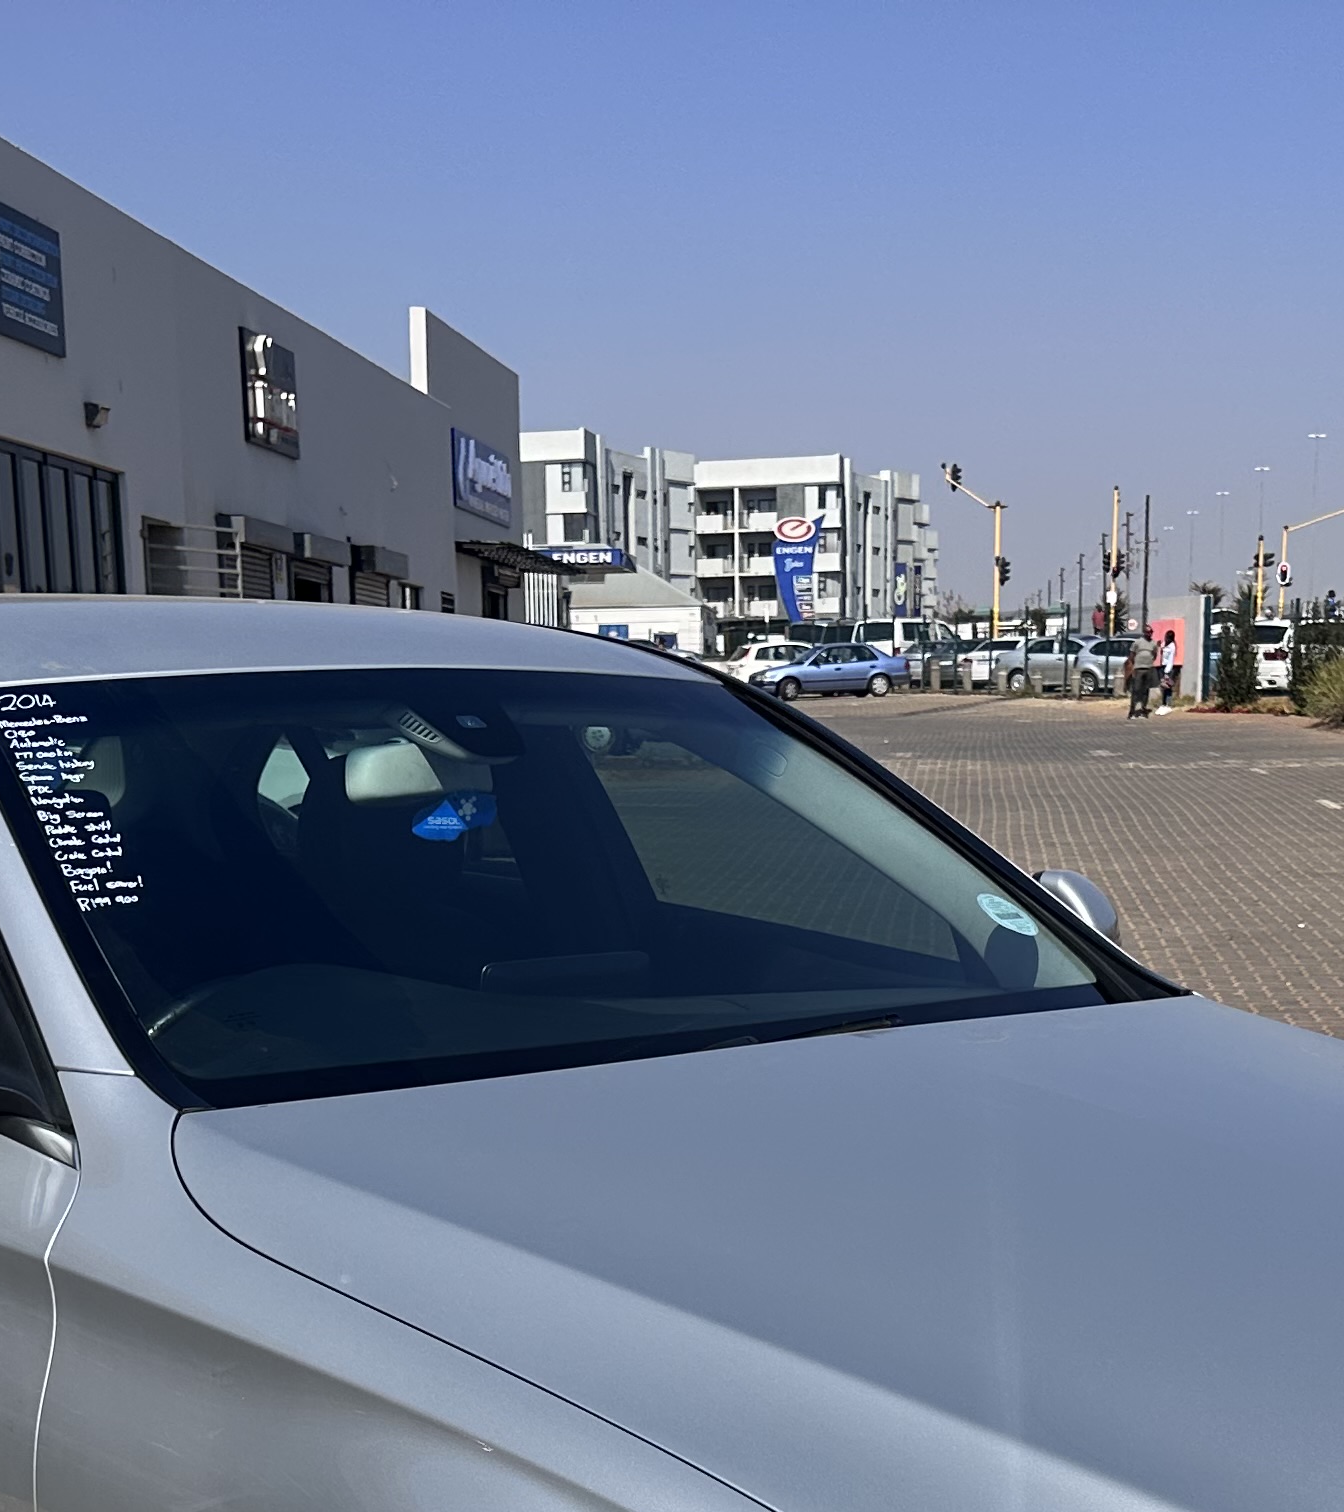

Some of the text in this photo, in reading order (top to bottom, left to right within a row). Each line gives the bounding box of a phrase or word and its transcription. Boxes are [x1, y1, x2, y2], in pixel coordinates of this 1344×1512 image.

[776, 546, 813, 555] ENGEN
[552, 551, 613, 564] ENGEN
[27, 785, 53, 795] PDC
[37, 810, 61, 824] Big
[69, 878, 99, 893] Fuel
